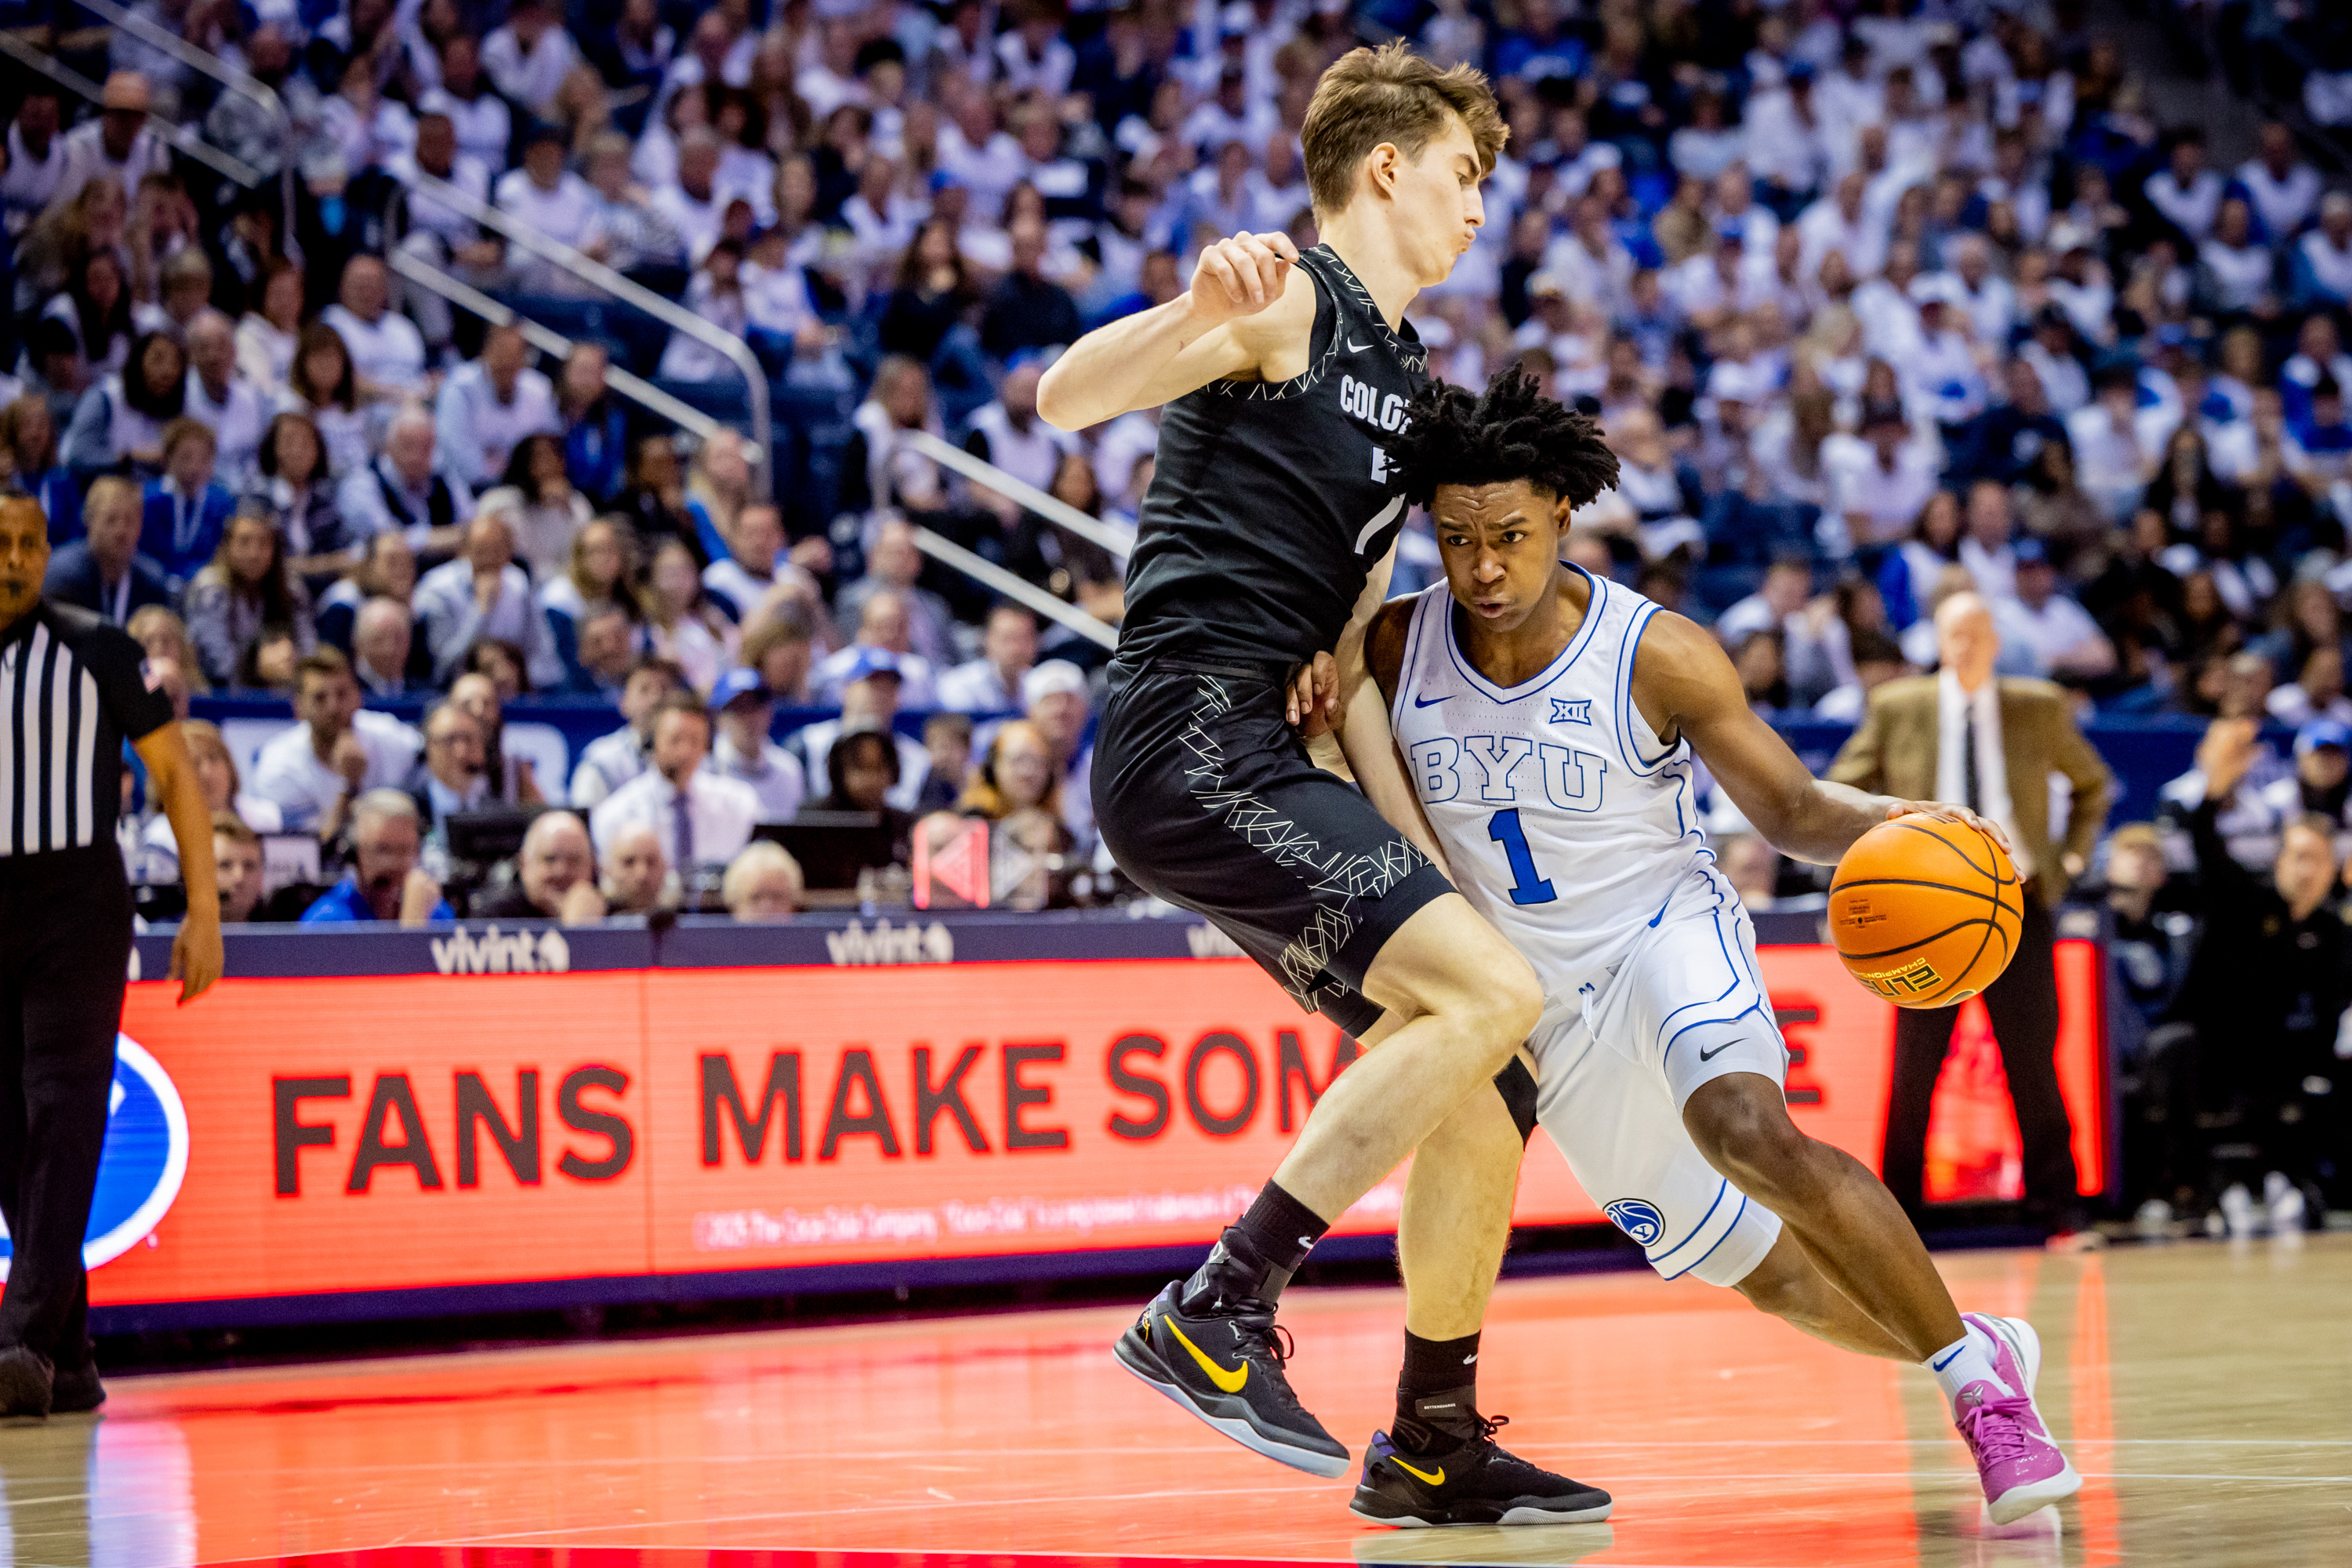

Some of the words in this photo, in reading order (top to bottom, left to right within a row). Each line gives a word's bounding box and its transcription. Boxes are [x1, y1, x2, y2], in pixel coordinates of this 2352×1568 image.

[1410, 735, 1606, 812] BYU
[1487, 808, 1558, 905] 1
[1858, 963, 1941, 996] ELITE
[273, 1065, 633, 1196] FANS
[699, 1044, 1069, 1164] MAKE
